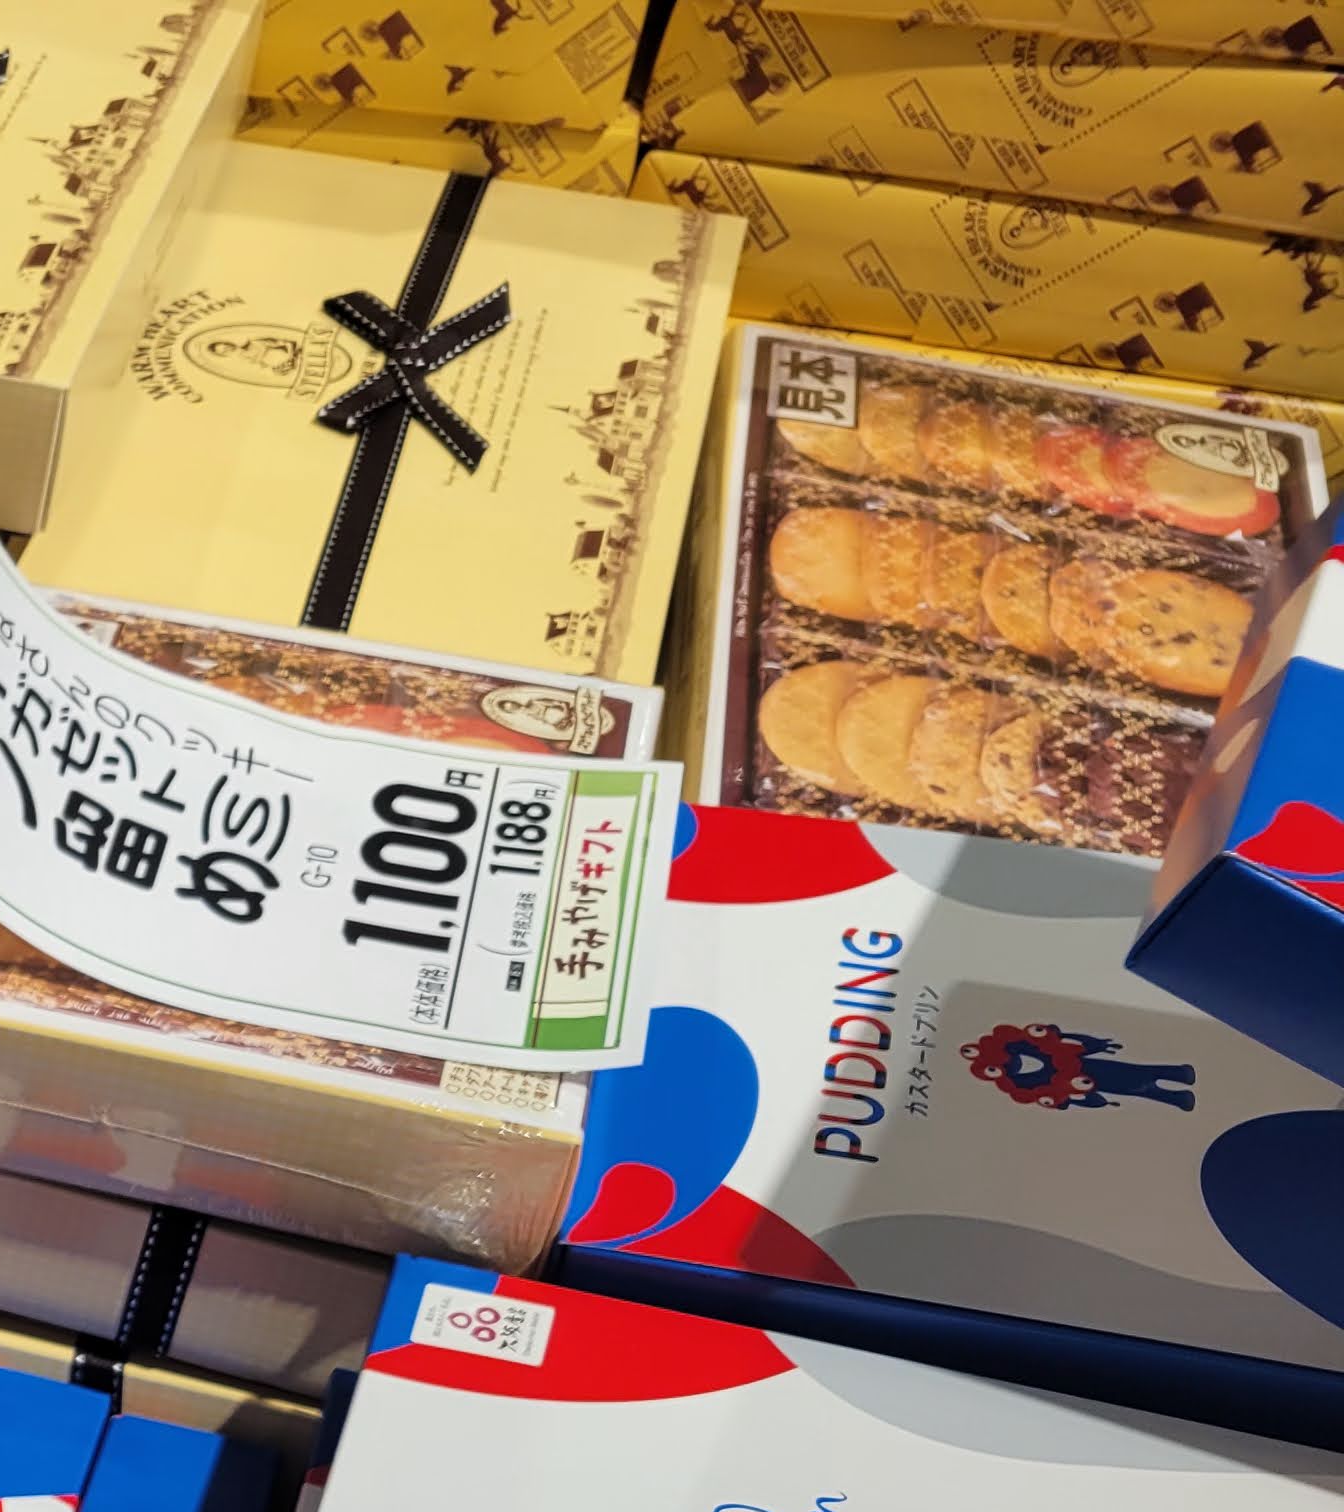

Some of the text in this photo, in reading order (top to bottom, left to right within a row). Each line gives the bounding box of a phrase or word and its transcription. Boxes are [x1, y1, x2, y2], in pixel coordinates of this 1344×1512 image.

[776, 350, 850, 422] 見本
[299, 844, 339, 889] G-10
[554, 819, 624, 981] 手みやげギフト
[812, 926, 904, 1165] PUDDING
[908, 984, 942, 1119] カスタードプリン
